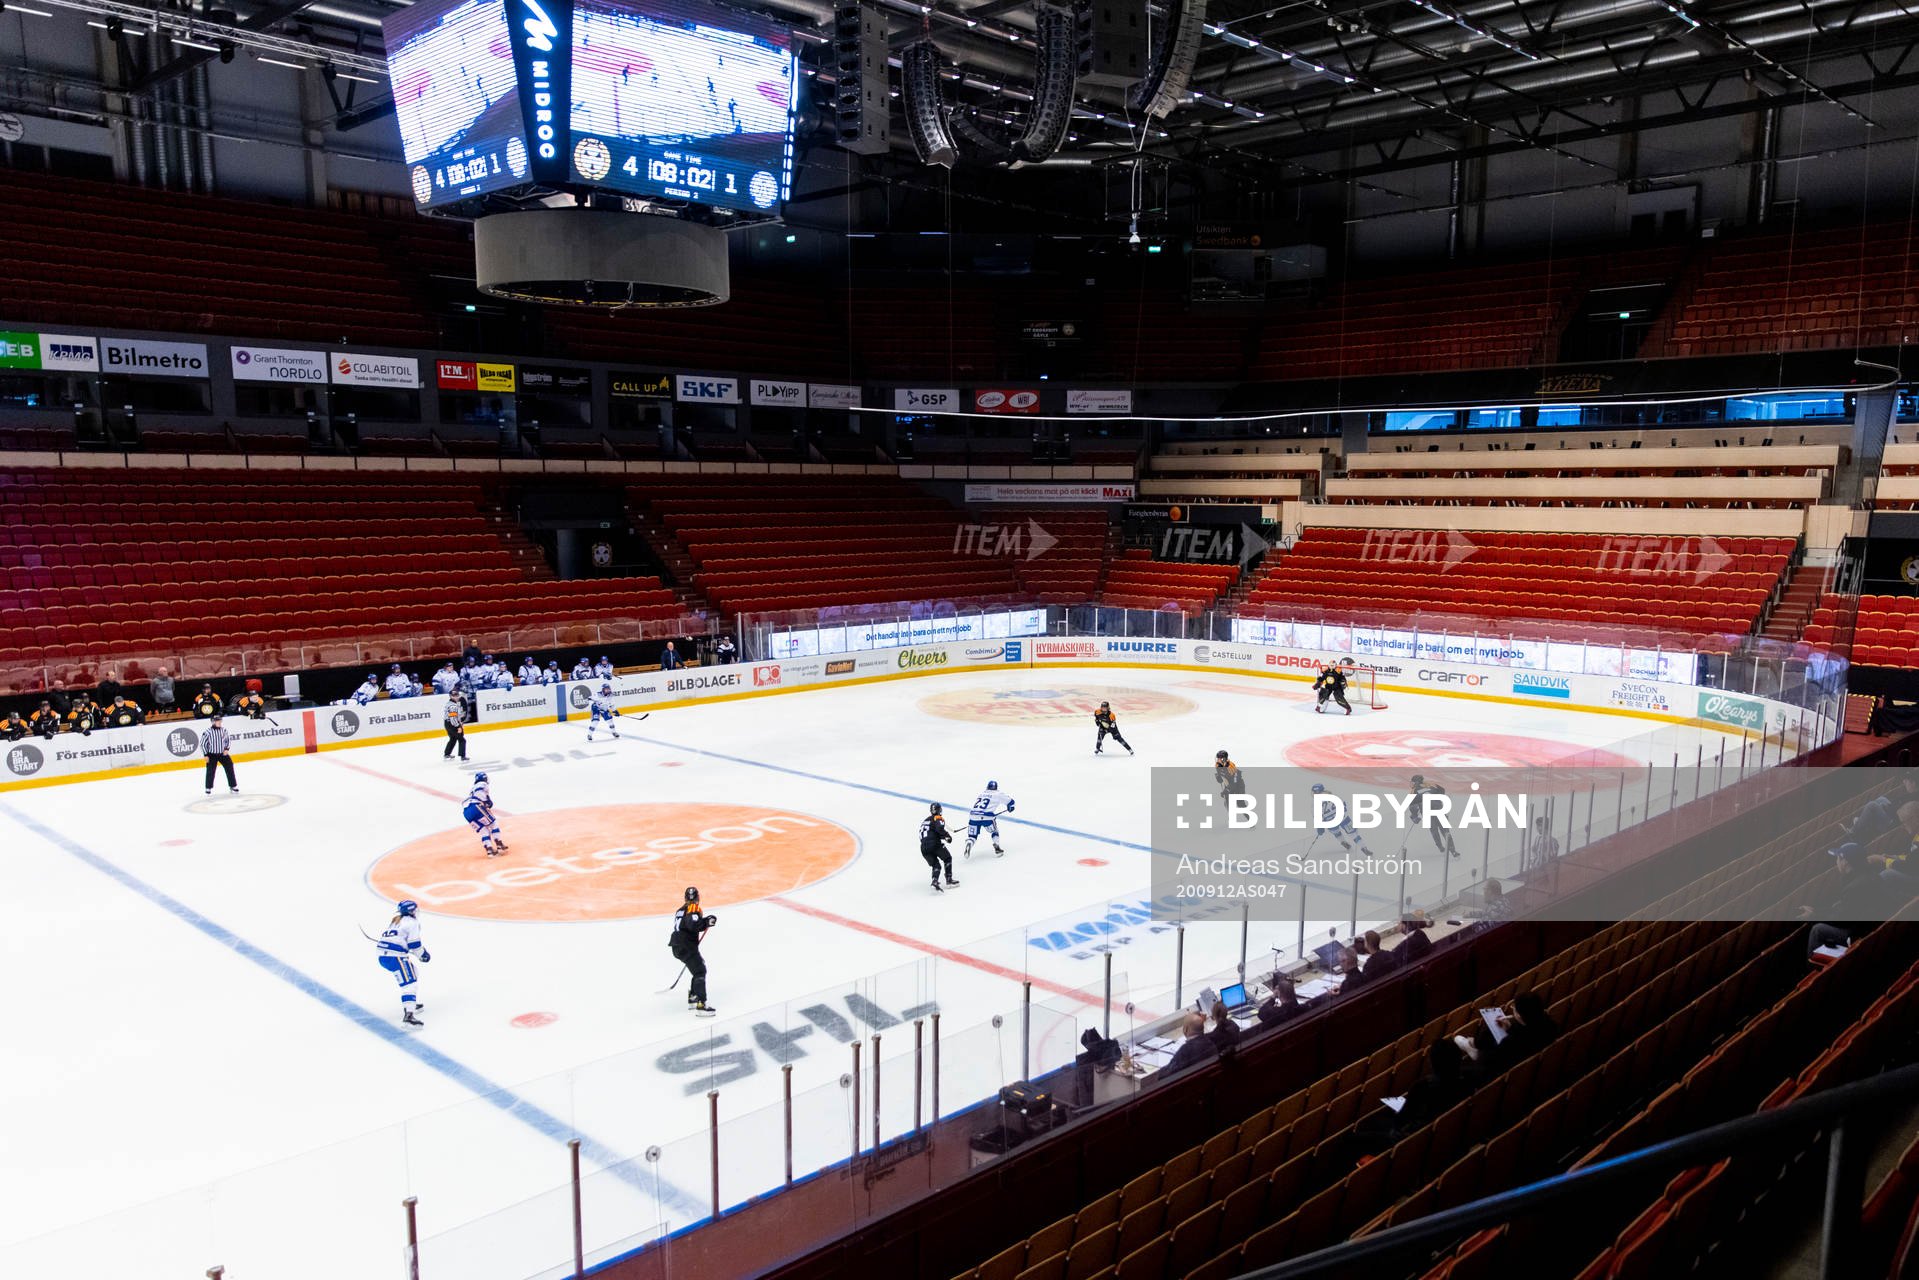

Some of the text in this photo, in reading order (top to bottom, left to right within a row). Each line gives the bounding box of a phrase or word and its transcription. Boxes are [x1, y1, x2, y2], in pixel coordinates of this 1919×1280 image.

[532, 61, 555, 158] MIDROC
[435, 169, 445, 188] 4
[489, 153, 502, 174] 1
[623, 156, 638, 176] 4
[725, 174, 738, 194] 1
[48, 350, 92, 362] KPMG
[108, 347, 202, 369] Bilmetro
[253, 354, 313, 366] Grant Thornton
[353, 363, 412, 376] COLABITOIL
[613, 382, 657, 393] CALL UP
[683, 381, 732, 398] SKF
[921, 393, 947, 405] GSP
[952, 523, 1022, 557] ITEM
[1160, 527, 1233, 561] ITEM
[1359, 528, 1437, 564] ITEM
[1595, 533, 1688, 577] ITEM
[965, 646, 997, 655] Combimix
[1036, 642, 1095, 654] HYRMASKINER
[1107, 641, 1177, 653] HUURRE
[1357, 637, 1371, 646] Det
[1373, 638, 1406, 650] handlar
[1447, 646, 1463, 655] om
[1479, 647, 1498, 658] nytt
[898, 649, 947, 670] Cheers
[1212, 651, 1252, 661] CASTELLUM
[1266, 654, 1322, 669] BORGA
[1384, 665, 1403, 674] affär
[667, 673, 742, 692] BILBOLAGET
[1513, 673, 1569, 688] SANDVIK
[621, 687, 657, 696] matchen
[1612, 690, 1665, 704] FREIGHT AB
[486, 698, 546, 711] För samhället
[369, 711, 431, 725] För alla barn
[170, 732, 181, 740] EN
[243, 727, 293, 739] matchen
[337, 725, 356, 734] START
[171, 738, 186, 746] BRA
[172, 744, 194, 753] START
[12, 749, 23, 758] EN
[56, 742, 146, 761] För samhället
[12, 756, 30, 765] BRA
[13, 761, 39, 772] START
[458, 749, 616, 776] SHL
[973, 797, 991, 810] 23
[393, 811, 819, 906] betsson
[654, 992, 942, 1098] SHL
